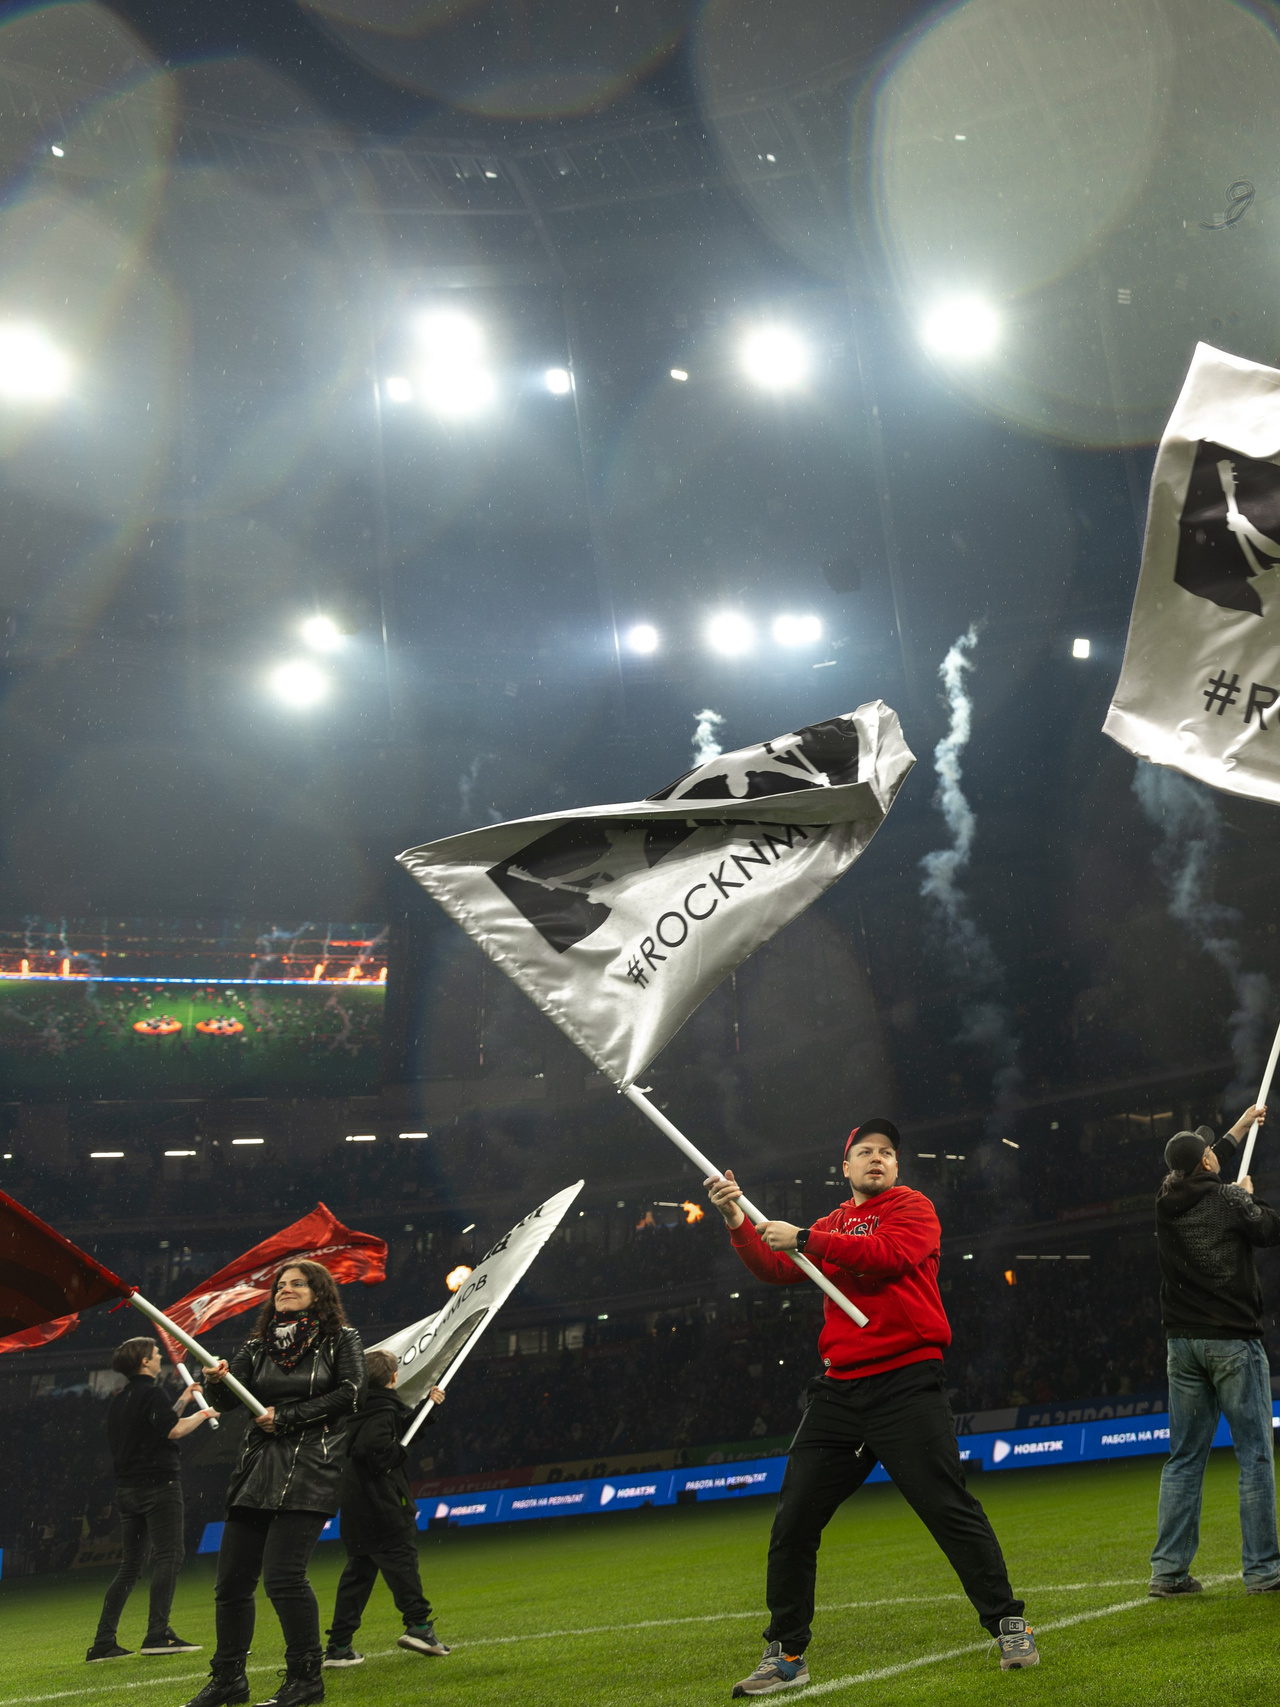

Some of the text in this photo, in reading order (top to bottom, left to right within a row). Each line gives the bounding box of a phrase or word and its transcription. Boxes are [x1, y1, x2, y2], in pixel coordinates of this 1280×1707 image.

[626, 823, 829, 990] #ROCKNM
[1101, 1432, 1137, 1445] РАБОТА
[1137, 1430, 1153, 1441] НА
[1013, 1440, 1064, 1455] НОВАТЭК
[685, 1472, 768, 1490] РАБОТА НА РЕЗУЛЬТАТ
[616, 1485, 657, 1499] НОВАТЭК
[449, 1503, 487, 1516] НОВАТЭК
[511, 1498, 537, 1510] РАБОТА
